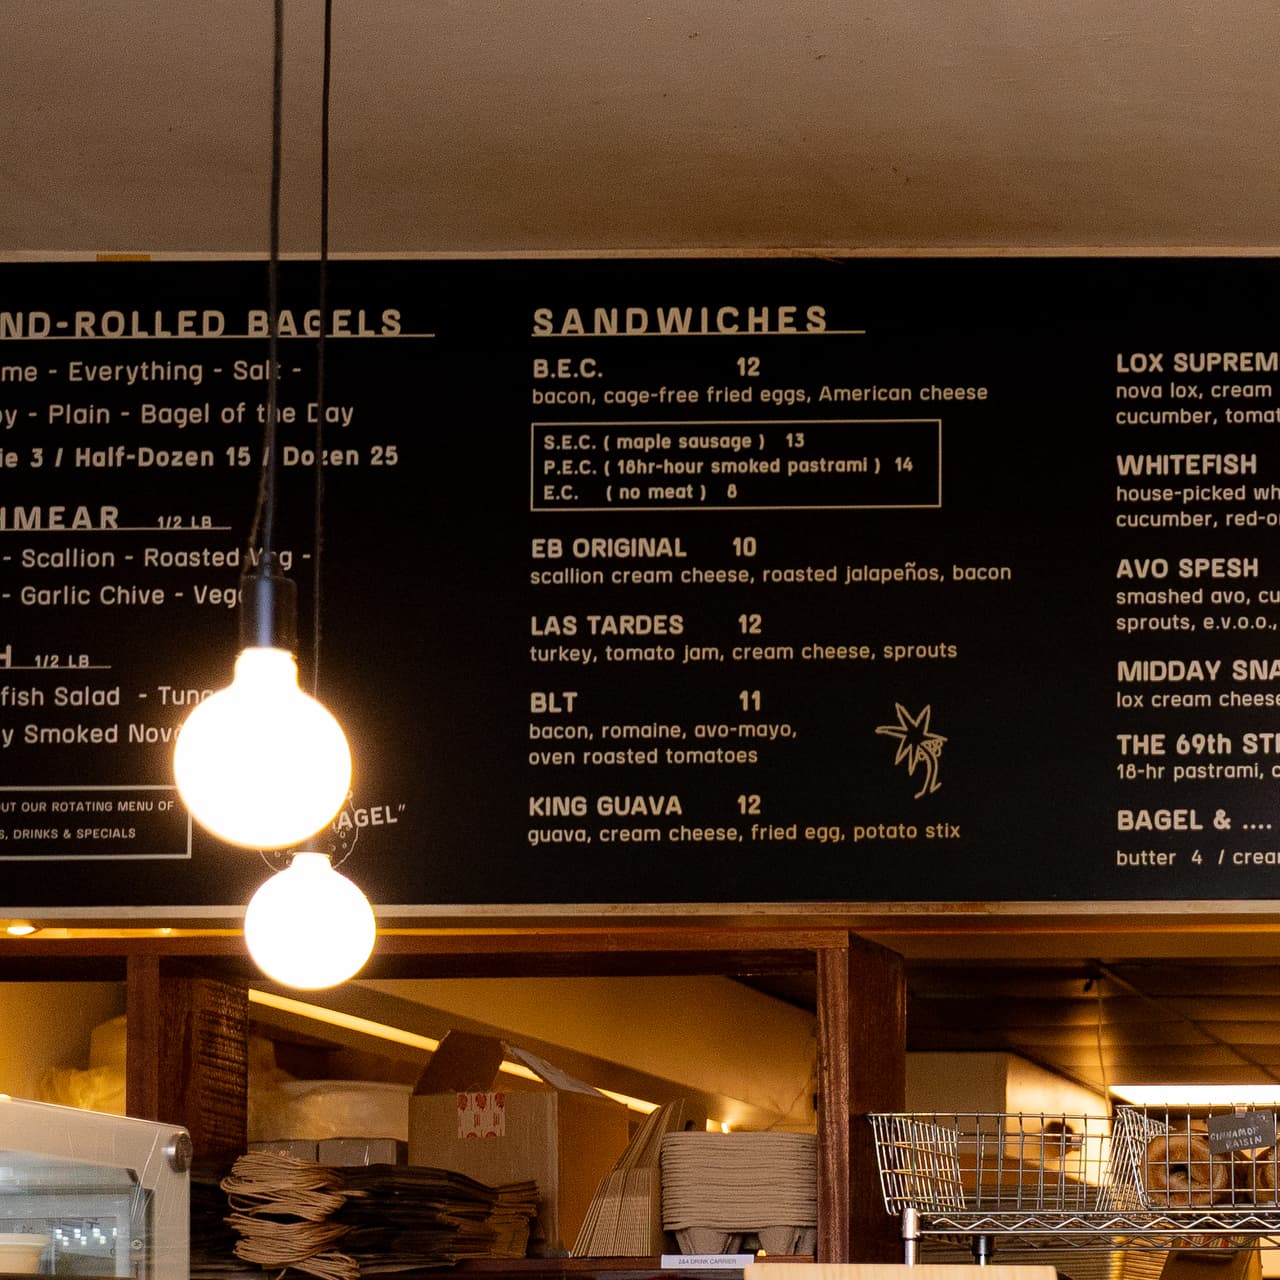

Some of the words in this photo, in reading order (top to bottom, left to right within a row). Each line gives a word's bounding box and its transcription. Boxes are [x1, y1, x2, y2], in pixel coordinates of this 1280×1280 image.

[248, 309, 402, 337] BAGELS
[533, 307, 828, 335] SANDWICHES
[69, 361, 203, 385] Everything
[533, 357, 603, 379] B.E.C.
[736, 356, 761, 377] 12
[1116, 352, 1164, 374] LOX
[532, 388, 596, 406] bacon,
[603, 386, 699, 408] cage-free
[706, 385, 753, 403] fried
[759, 388, 812, 406] eggs,
[818, 385, 912, 402] American
[919, 384, 989, 401] cheese
[49, 403, 110, 425] Plain
[141, 402, 209, 428] Bagel
[221, 402, 246, 424] of
[543, 434, 597, 451] S.E.C.
[616, 433, 672, 453] maple
[678, 435, 753, 453] sausage
[785, 432, 805, 448] 13
[30, 447, 44, 468] 3
[75, 446, 215, 468] Half-Dozen
[225, 446, 251, 467] 15
[283, 446, 359, 467] Dozen
[370, 445, 399, 467] 25
[543, 459, 597, 475] P.E.C.
[617, 458, 704, 475] 18hr-hour
[710, 457, 781, 474] smoked
[787, 456, 868, 477] pastrami
[894, 456, 914, 472] 14
[1116, 453, 1257, 476] WHITEFISH
[1116, 484, 1246, 505] house-picked
[157, 515, 183, 530] 1/2
[191, 515, 213, 530] LB
[21, 548, 116, 568] Scallion
[144, 547, 240, 568] Roasted
[248, 548, 293, 571] Vg
[531, 538, 563, 559] EB
[572, 537, 688, 559] ORIGINAL
[732, 536, 757, 557] 10
[1116, 558, 1169, 579] AVO
[1178, 557, 1259, 579] SPESH
[21, 585, 91, 605] Garlic
[100, 585, 165, 605] Chive
[531, 615, 578, 636] LAS
[586, 614, 684, 636] TARDES
[738, 613, 762, 635] 12
[34, 654, 59, 669] 1/2
[68, 654, 90, 669] LB
[529, 645, 598, 665] turkey,
[605, 645, 676, 662] tomato
[682, 644, 725, 664] jam,
[731, 646, 794, 661] cream
[801, 643, 876, 661] cheese,
[883, 642, 958, 662] sprouts
[1117, 659, 1222, 682] MIDDAY
[54, 685, 121, 706] Salad
[530, 691, 578, 714] BLT
[739, 690, 761, 712] 11
[24, 723, 118, 744] Smoked
[529, 723, 594, 741] bacon,
[601, 722, 687, 740] romaine,
[694, 723, 797, 741] avo-mayo,
[1116, 733, 1166, 756] THE
[1175, 733, 1232, 756] 69th
[1116, 763, 1166, 780] 18-hr
[1173, 762, 1264, 783] pastrami,
[21, 801, 47, 813] OUR
[51, 800, 113, 813] ROTATING
[117, 800, 154, 812] MENU
[158, 800, 174, 812] OF
[529, 795, 588, 817] KING
[596, 795, 683, 817] GUAVA
[737, 794, 761, 815] 12
[1117, 808, 1204, 831] BAGEL
[1212, 808, 1232, 830] &
[13, 828, 59, 840] DRINKS
[63, 828, 72, 840] &
[76, 827, 136, 840] SPECIALS
